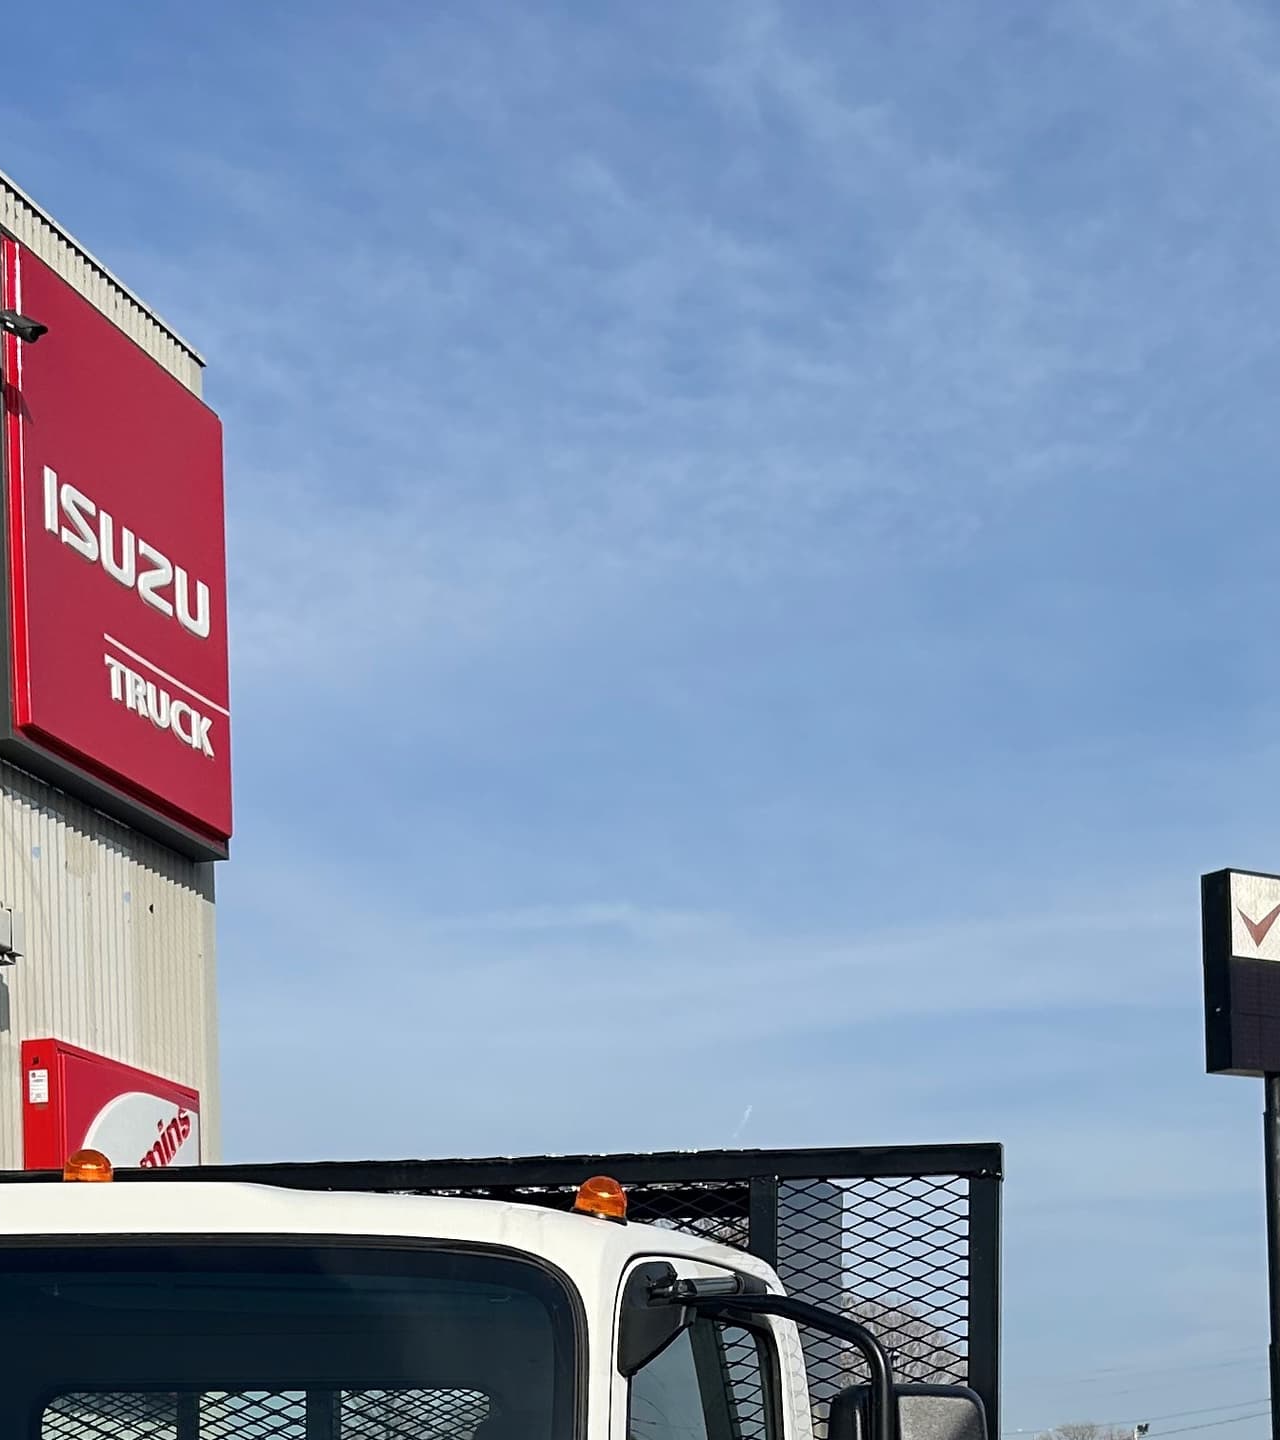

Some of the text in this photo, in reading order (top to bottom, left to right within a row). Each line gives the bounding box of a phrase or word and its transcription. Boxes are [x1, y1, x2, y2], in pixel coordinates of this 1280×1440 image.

[43, 465, 210, 638] ISUZU
[104, 653, 215, 759] TRUCK
[140, 1108, 191, 1168] mins
